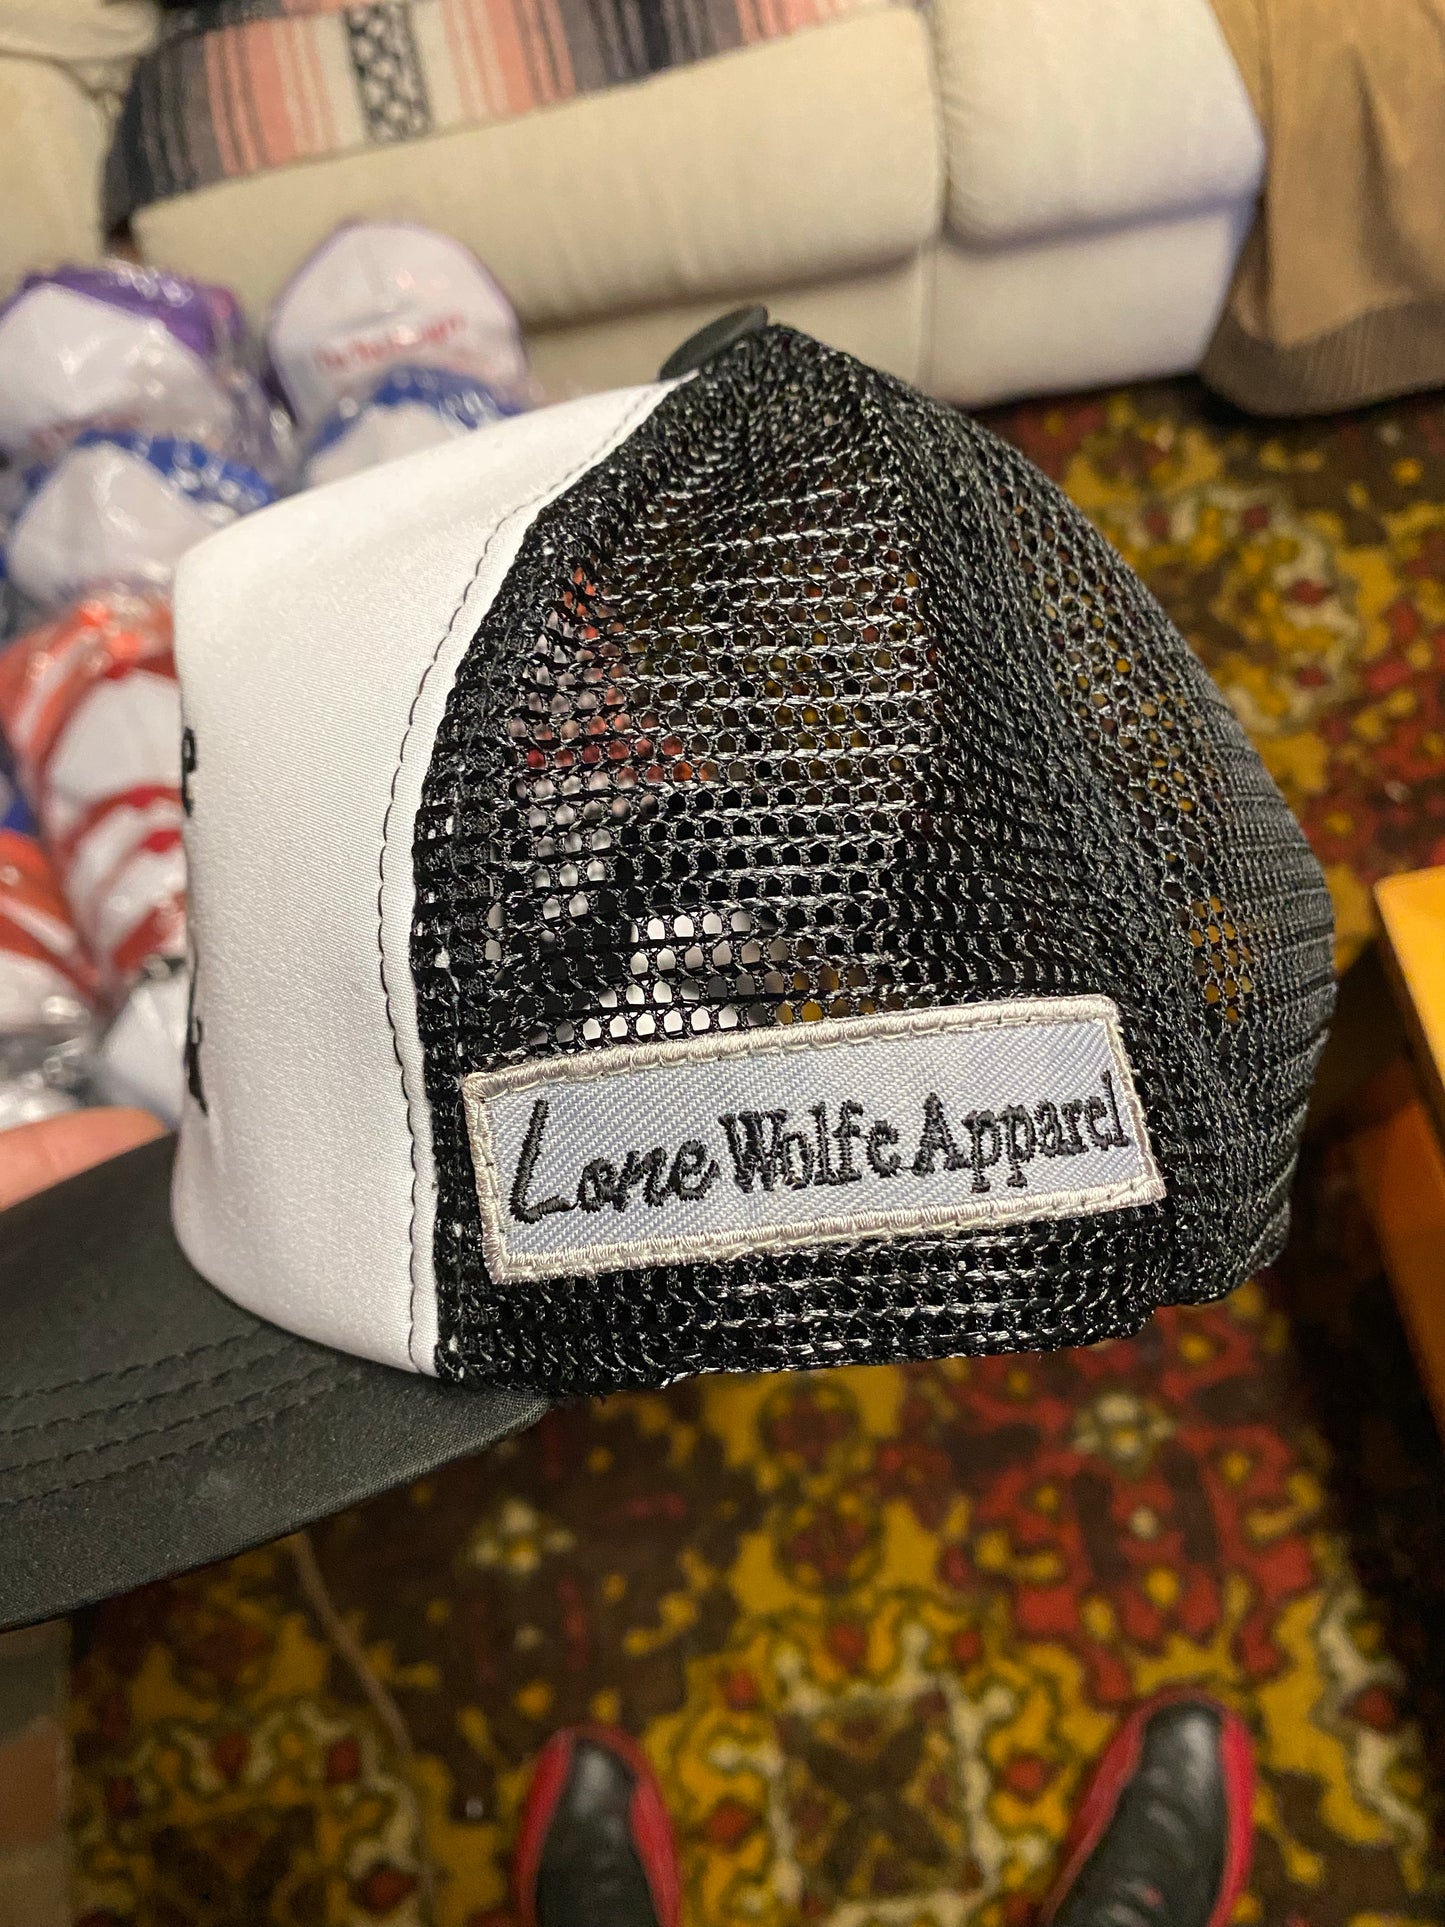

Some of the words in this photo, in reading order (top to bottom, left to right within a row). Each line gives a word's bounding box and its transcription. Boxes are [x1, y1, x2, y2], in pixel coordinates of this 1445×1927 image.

[509, 1098, 720, 1225] Lone
[717, 1099, 904, 1194] Wolfe
[910, 1068, 1132, 1195] Apparel
